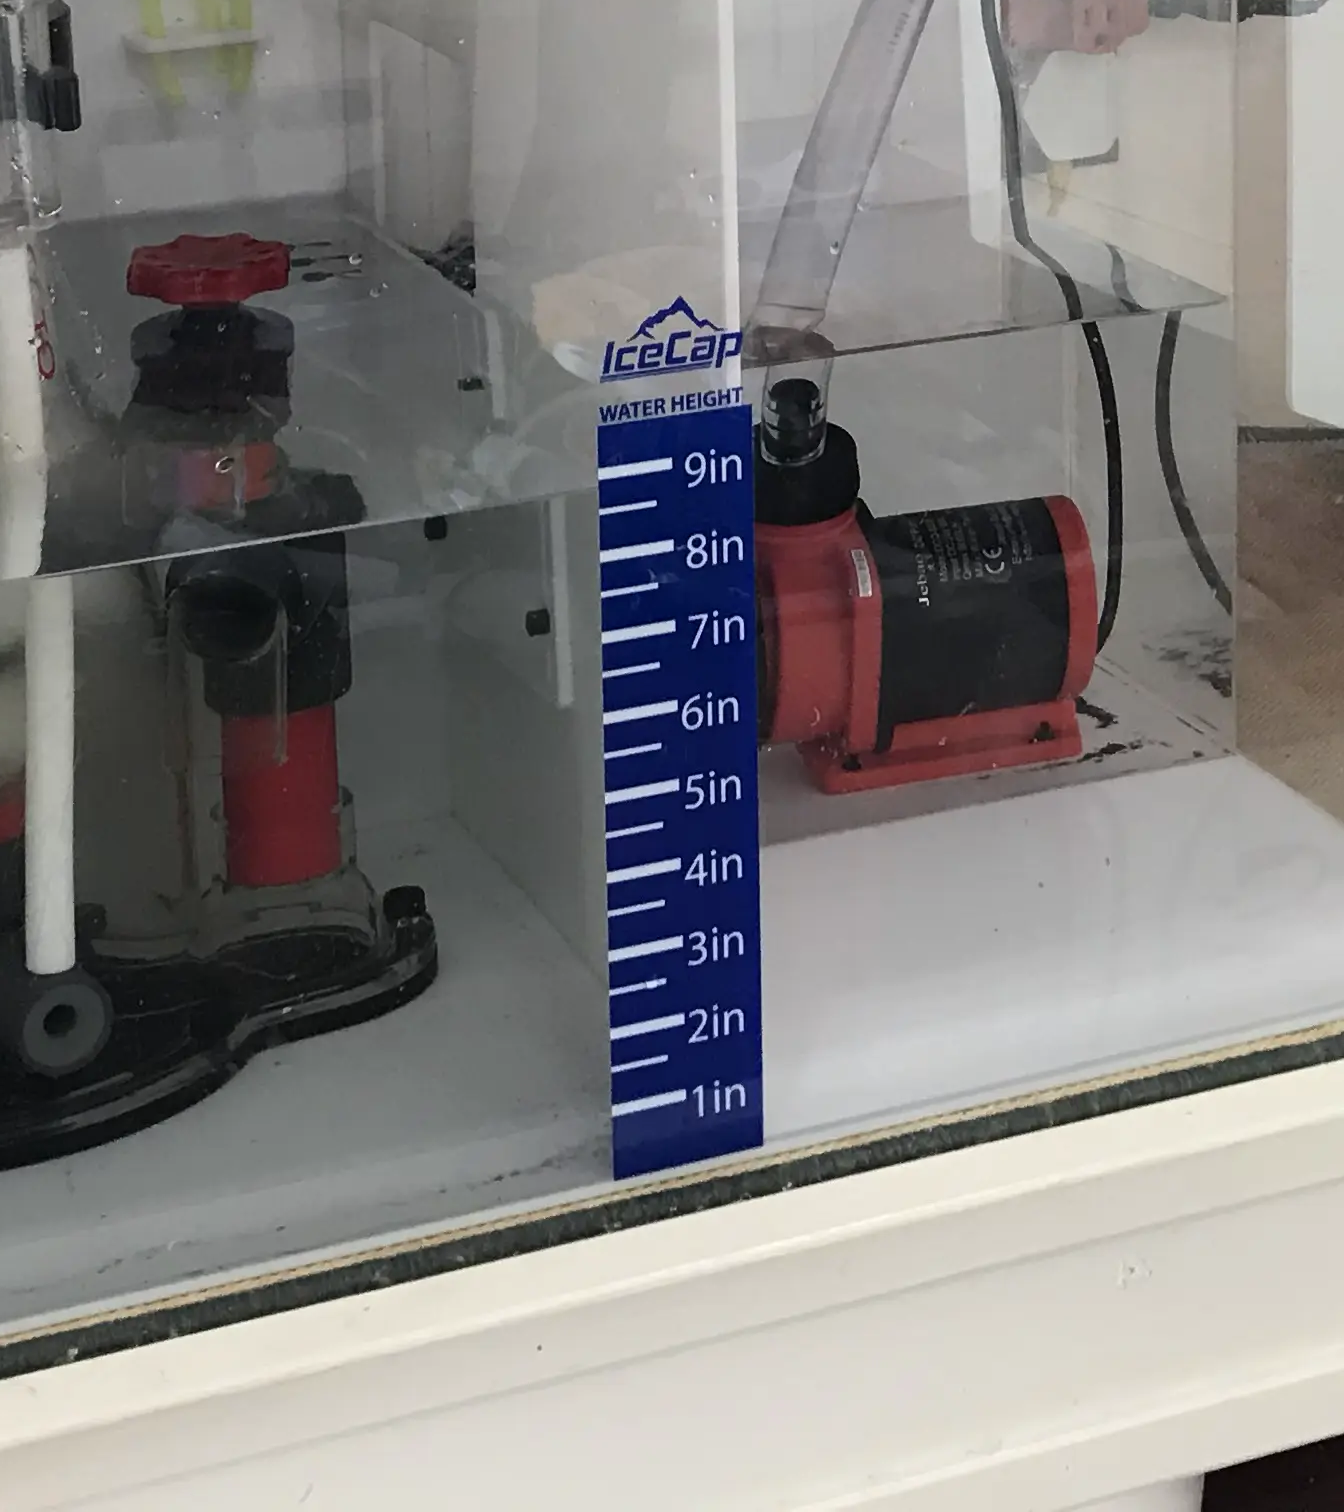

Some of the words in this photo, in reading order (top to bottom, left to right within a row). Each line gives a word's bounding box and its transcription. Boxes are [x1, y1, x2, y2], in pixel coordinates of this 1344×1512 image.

[602, 329, 744, 375] IceCap
[598, 396, 666, 424] WATER
[670, 386, 744, 412] HEIGHT
[684, 448, 743, 489] 9in
[685, 529, 744, 570] 8in
[687, 611, 745, 651] 7in
[680, 692, 740, 732] 6in
[684, 771, 742, 811] 5in
[683, 849, 743, 887] 4in
[686, 926, 745, 968] 3in
[687, 1003, 745, 1044] 2in
[691, 1079, 747, 1119] 1in
